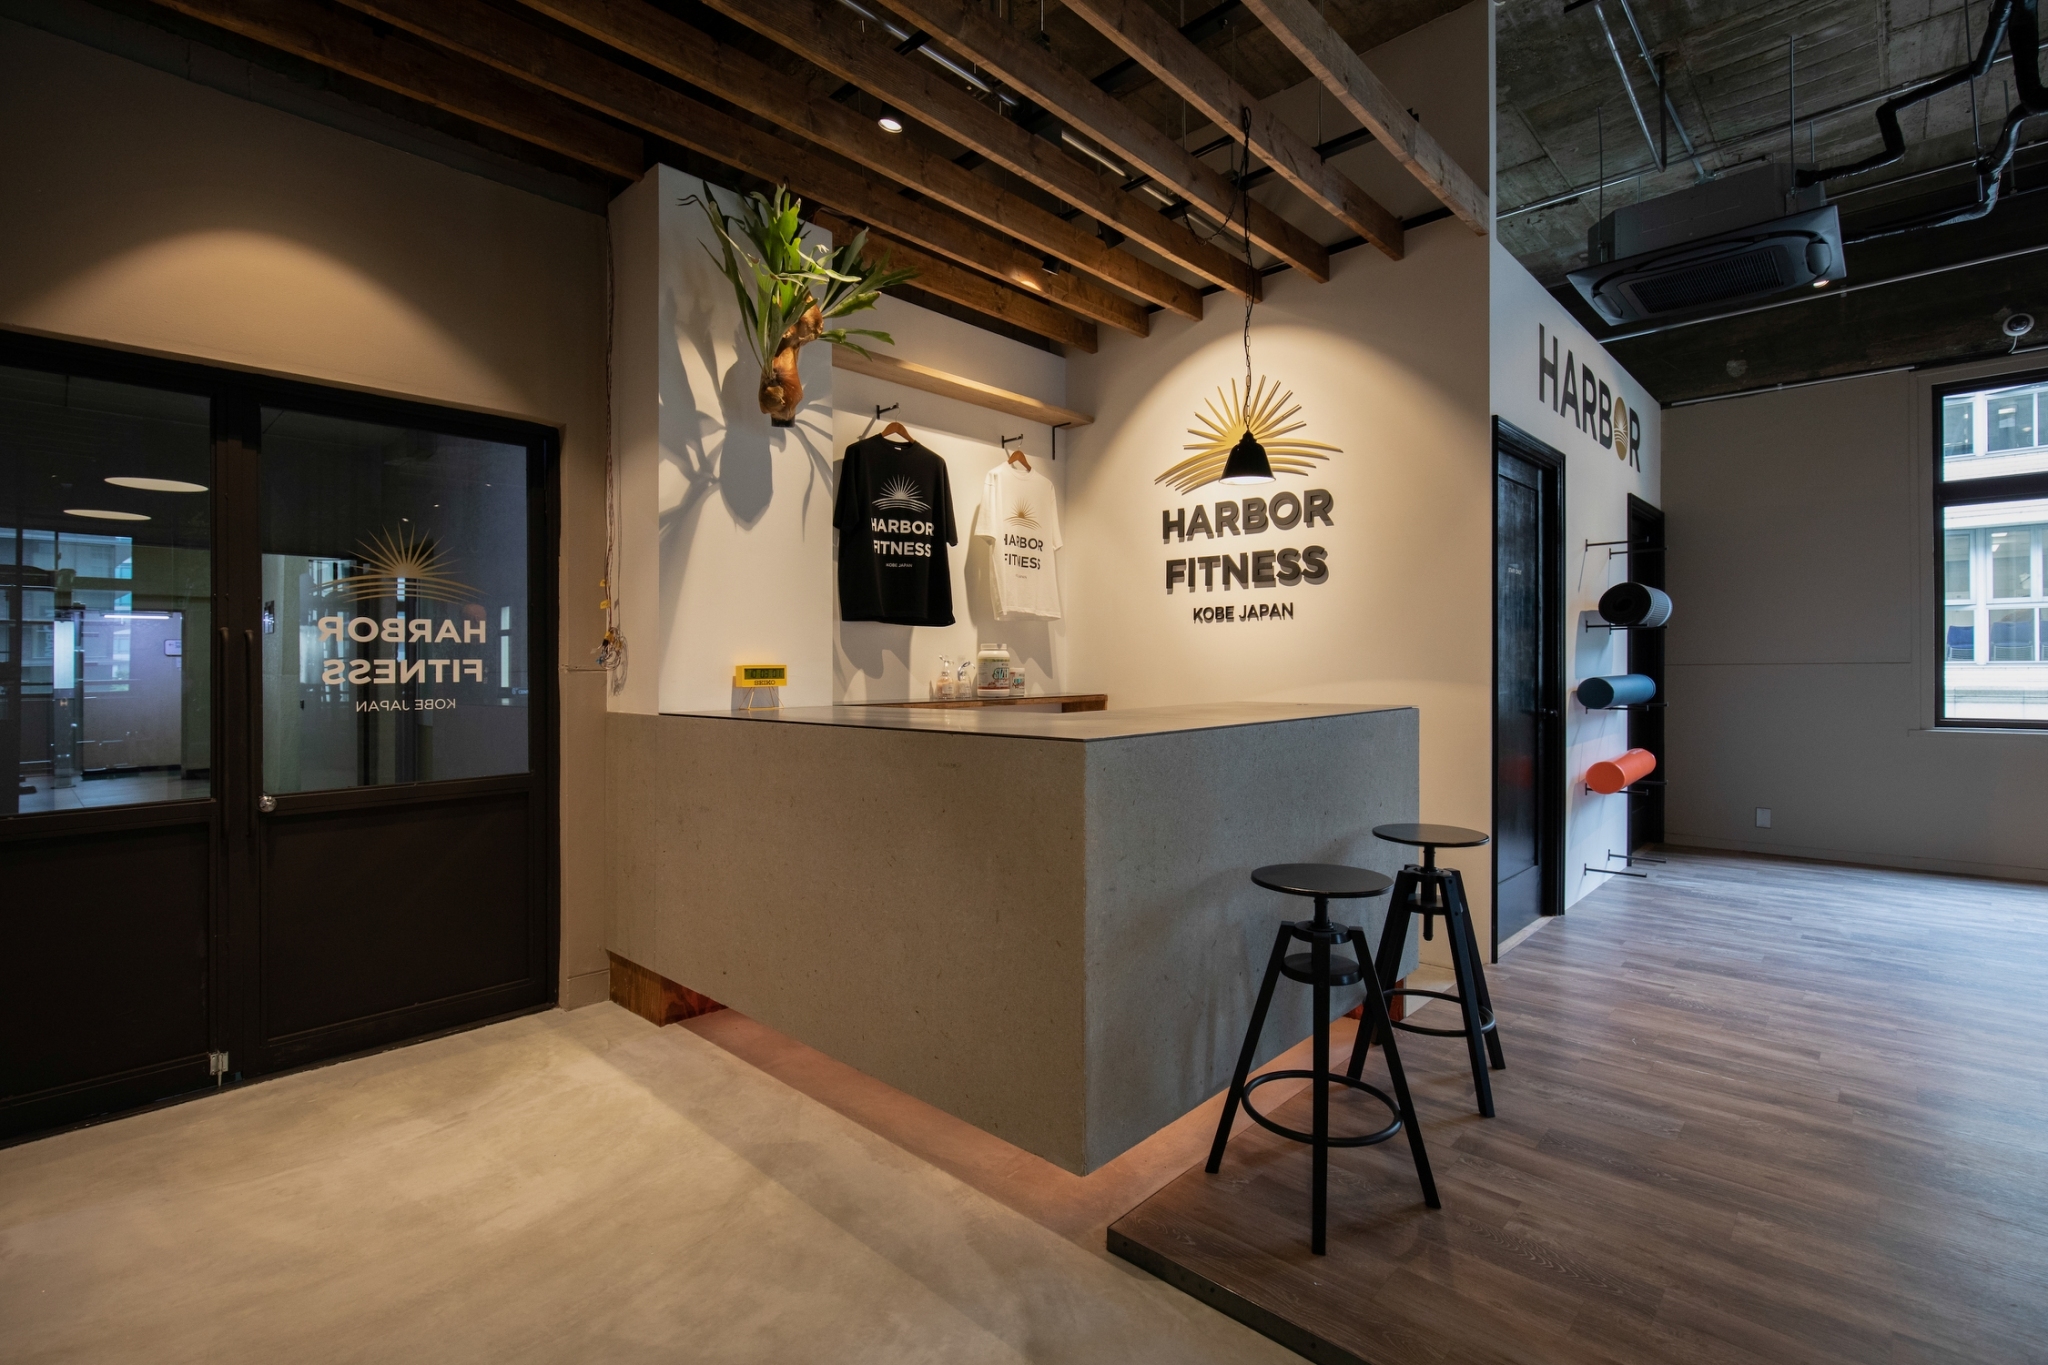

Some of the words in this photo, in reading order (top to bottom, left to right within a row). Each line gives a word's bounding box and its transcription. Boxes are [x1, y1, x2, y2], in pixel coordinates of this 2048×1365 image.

[1539, 323, 1641, 473] HARBOR
[871, 517, 934, 536] HARBOR
[1162, 488, 1334, 542] HARBOR
[873, 540, 931, 557] FITNESS
[1166, 545, 1328, 590] FITNESS
[1193, 606, 1234, 623] KOBE
[1239, 602, 1294, 620] JAPAN
